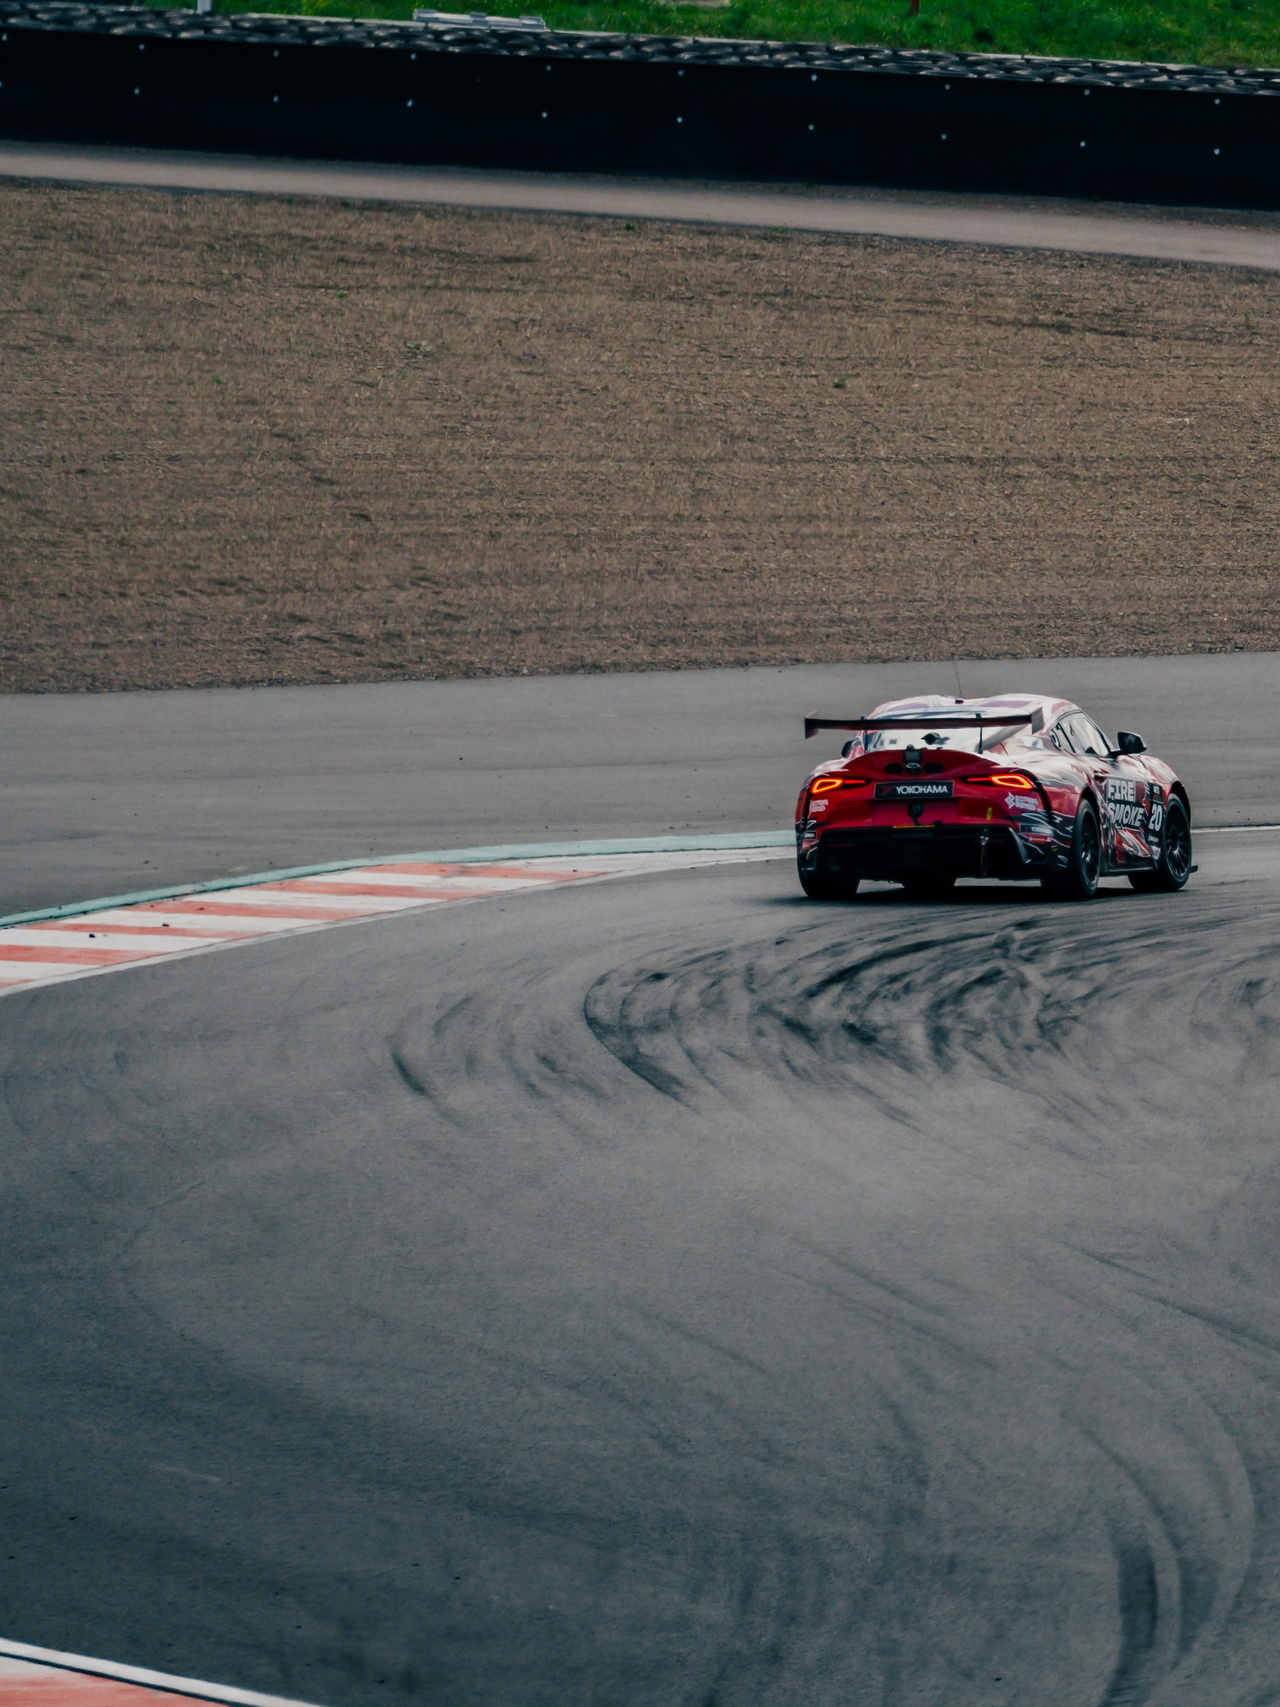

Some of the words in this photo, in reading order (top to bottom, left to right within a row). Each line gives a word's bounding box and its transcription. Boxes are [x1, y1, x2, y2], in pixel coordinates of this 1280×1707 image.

[895, 785, 948, 795] YOKOHAMA
[1108, 779, 1134, 802] FIRE
[1107, 802, 1145, 827] SMOKE
[1148, 803, 1163, 831] 20
